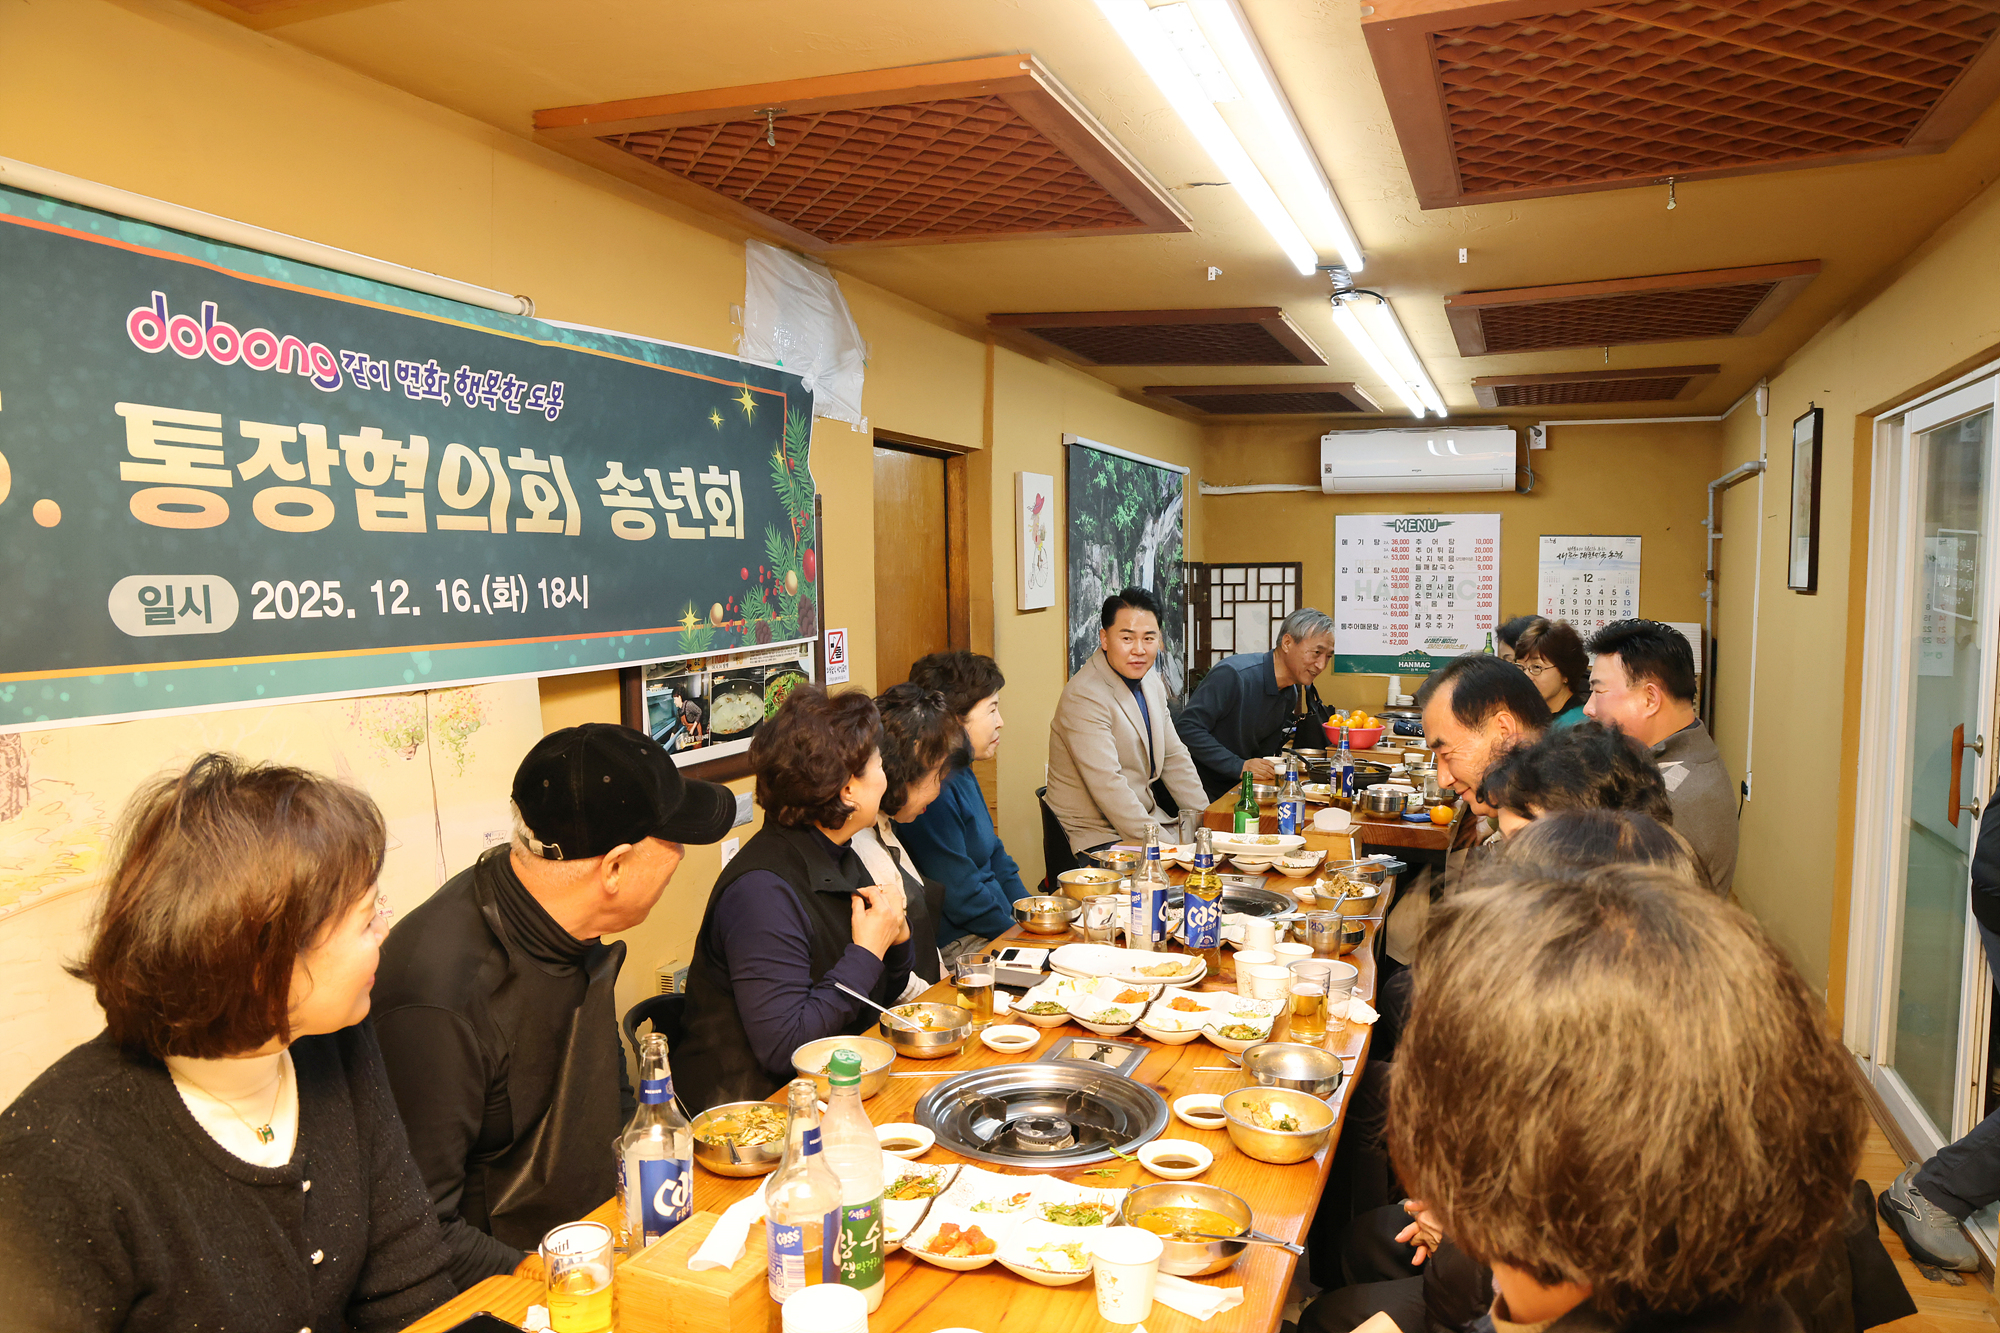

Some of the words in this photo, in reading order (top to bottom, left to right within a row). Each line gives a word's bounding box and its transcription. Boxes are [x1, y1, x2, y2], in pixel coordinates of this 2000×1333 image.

[126, 290, 344, 392] dobong
[395, 359, 450, 407] 변화,
[454, 365, 527, 414] 행복한
[525, 381, 564, 422] 도봉
[114, 401, 582, 537] 통장협의회
[595, 460, 746, 542] 송년회
[1394, 519, 1439, 533] MENU
[250, 579, 356, 621] 2025.
[370, 579, 421, 617] 12.
[537, 574, 590, 610] 18시
[1583, 574, 1593, 583] 12
[137, 584, 213, 626] 일시
[1197, 923, 1217, 933] FRESH
